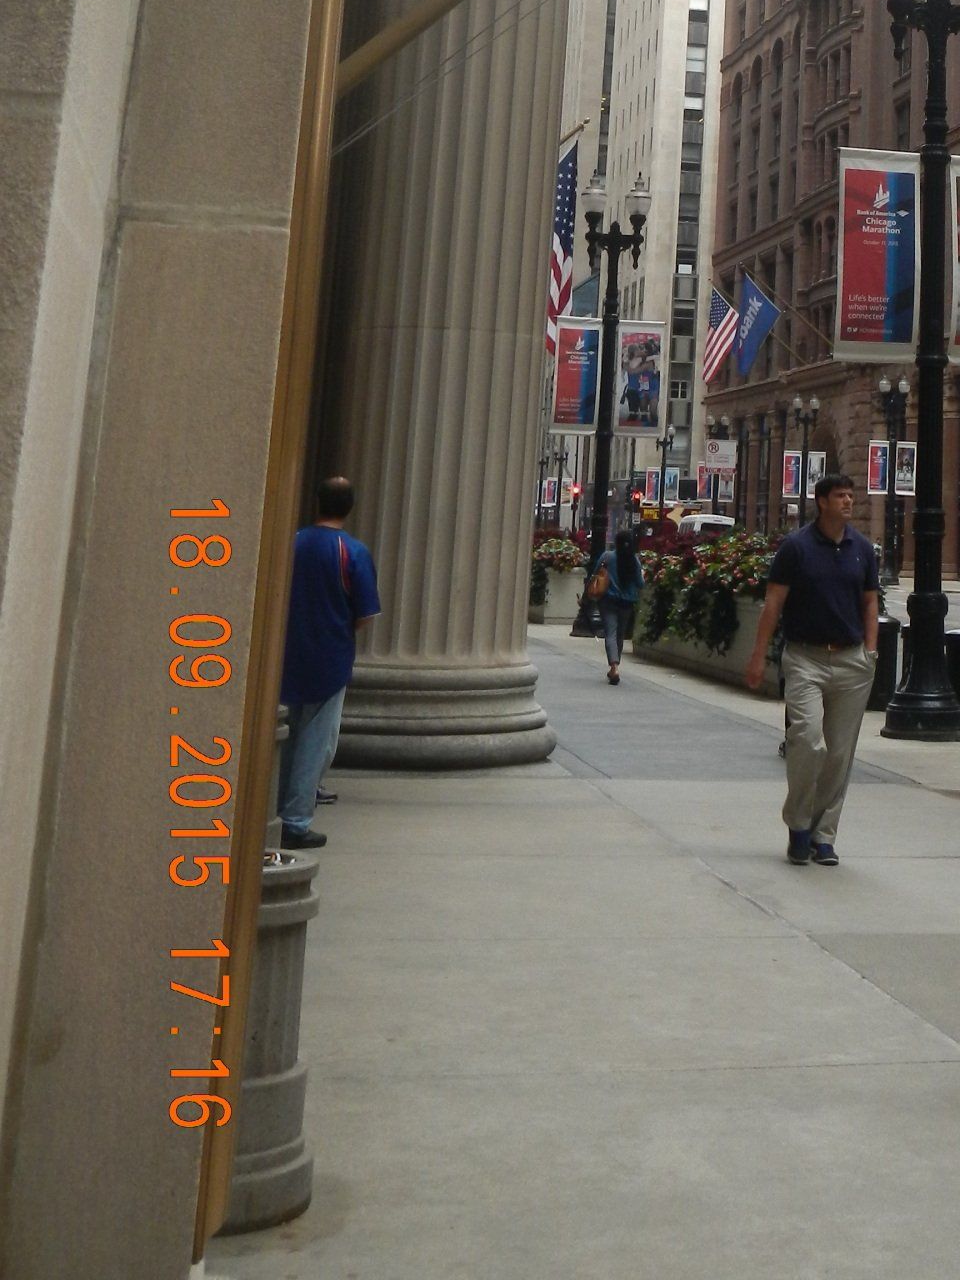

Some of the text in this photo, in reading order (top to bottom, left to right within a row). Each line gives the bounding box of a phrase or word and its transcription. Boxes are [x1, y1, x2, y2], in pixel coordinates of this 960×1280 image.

[865, 217, 897, 227] Chicago
[862, 225, 901, 234] Marathon
[848, 294, 890, 303] Life's better
